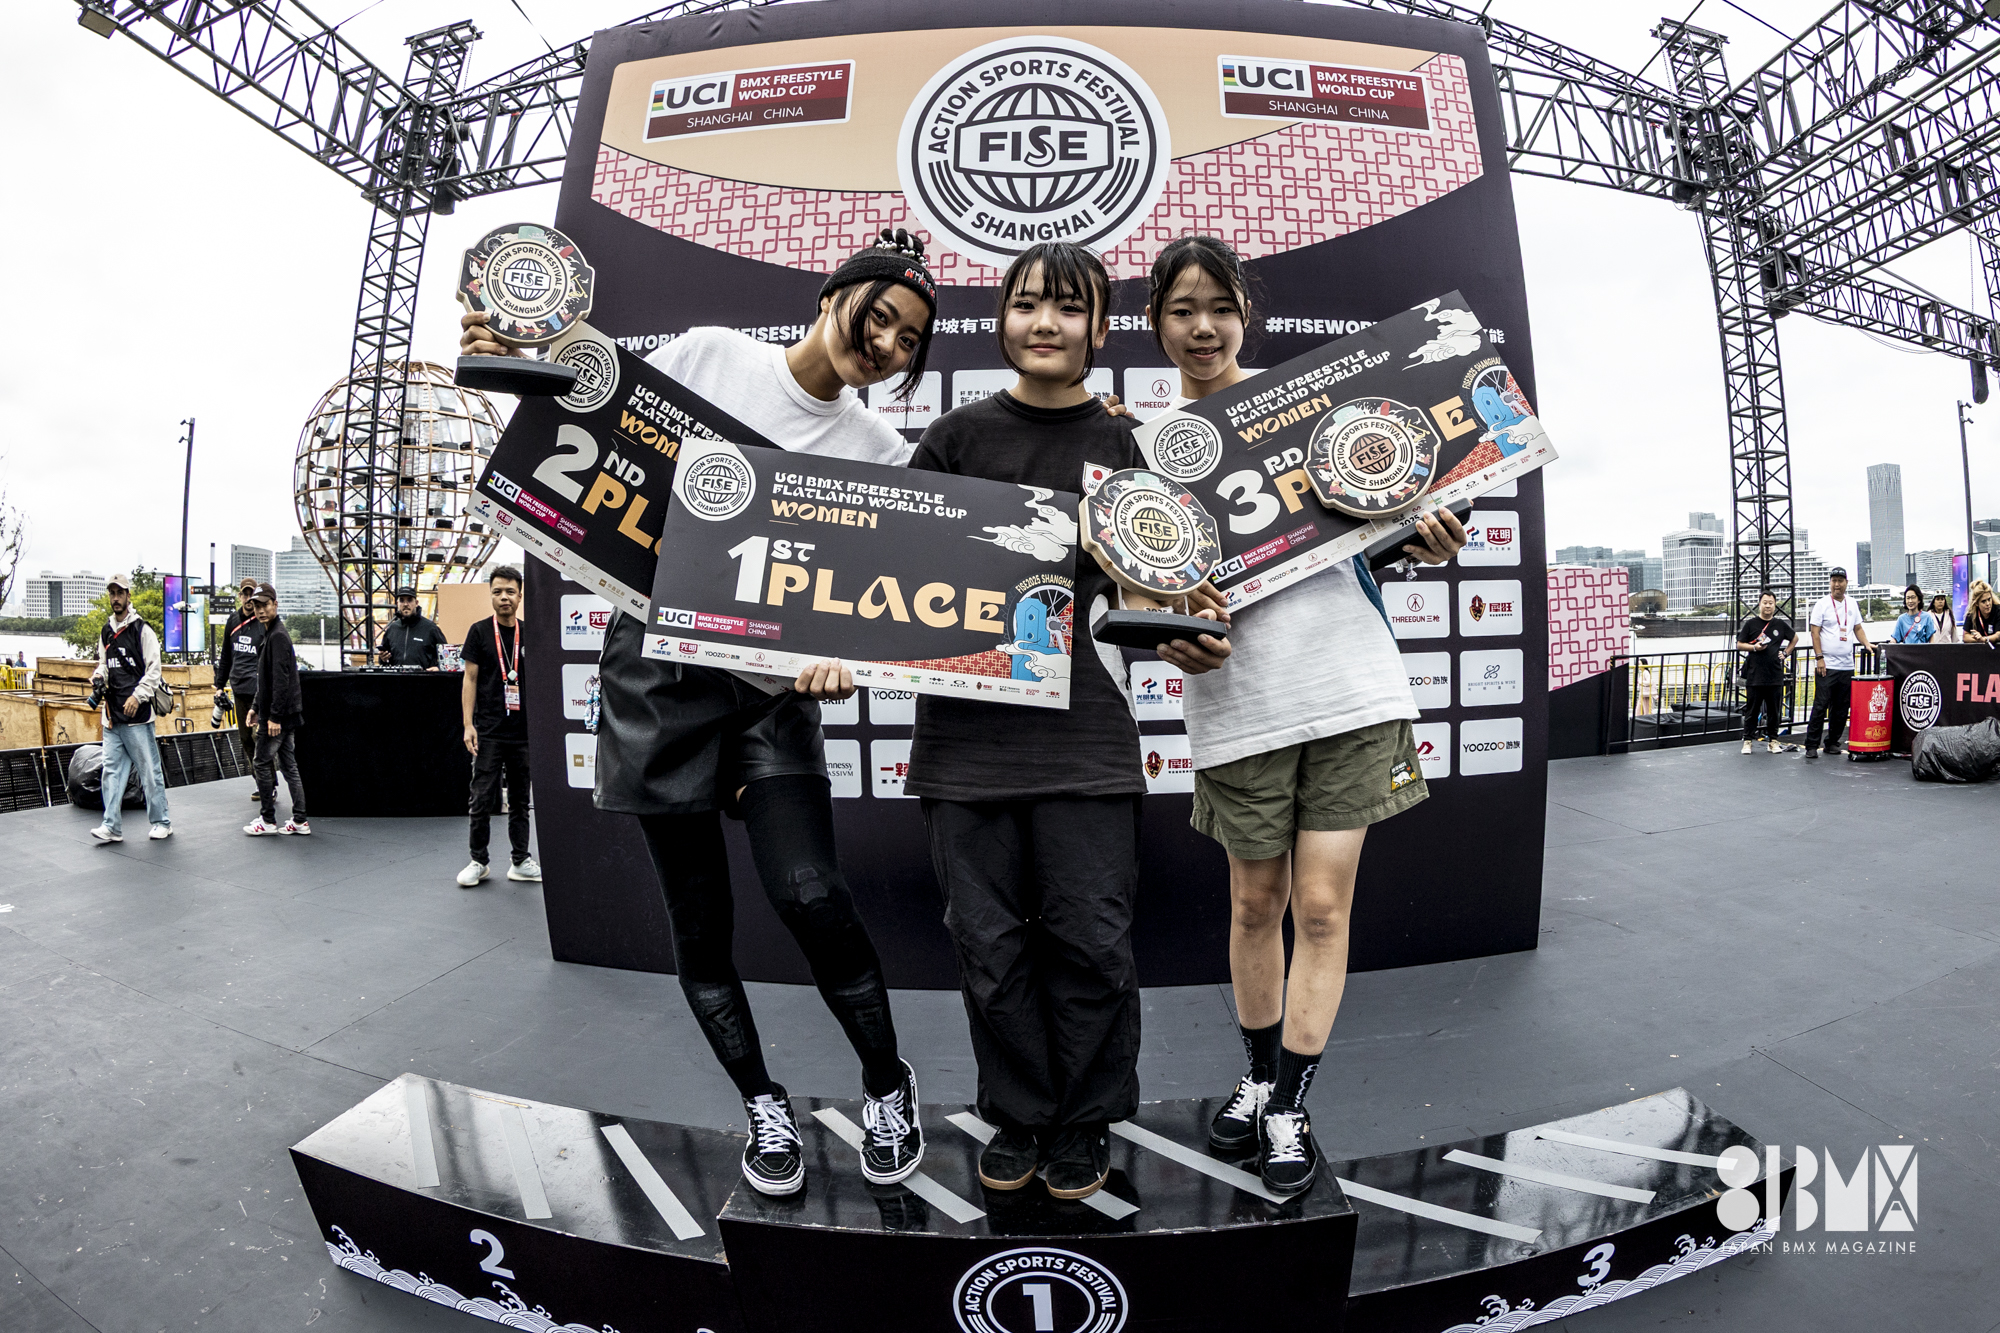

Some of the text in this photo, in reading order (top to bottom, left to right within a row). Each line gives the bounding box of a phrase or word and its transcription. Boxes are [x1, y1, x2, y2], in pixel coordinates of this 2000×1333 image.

[740, 70, 844, 88] BMX FREESTYLE
[1238, 65, 1305, 91] UCI
[1316, 71, 1418, 91] BMX FREESTYLE
[666, 81, 728, 109] UCI
[738, 84, 816, 101] WORLD CUP
[1318, 84, 1395, 100] WORLD CUP
[686, 106, 804, 128] SHANGHAI CHINA
[928, 59, 1140, 154] ACTION SPORTS FESTIVAL
[1268, 100, 1390, 120] SHANGHAI CHINA
[979, 125, 1087, 168] FISE
[971, 209, 1095, 242] SHANGHAI
[492, 246, 563, 286] ACTION SPORTS FESTIVAL
[510, 272, 544, 286] FISE
[504, 300, 544, 314] SHANGHAI
[560, 344, 612, 389] ACTION SPORTS FESTIVAL
[1462, 357, 1501, 390] FISE2025 SHANGHAI
[1225, 350, 1368, 418] UCI BMX FREESTYLE
[1231, 351, 1391, 427] FLATLAND WORLD CUP
[634, 384, 660, 404] UCI
[660, 401, 694, 427] BMX
[878, 405, 914, 413] THREEGUN
[1238, 393, 1332, 444] WOMEN
[1163, 422, 1186, 439] SPORTS
[1186, 421, 1211, 441] FESTIVAL
[1172, 437, 1200, 457] FISE
[1338, 421, 1402, 470] ACTION SPORTS FESTIVAL
[1358, 442, 1389, 465] FISE
[688, 457, 747, 489] ACTION SPORTS FESTIVAL
[1180, 458, 1211, 475] SHANGHAI
[1369, 465, 1405, 487] SHANGHAI
[494, 476, 519, 499] UCI
[702, 478, 732, 491] FISE
[774, 471, 945, 505] UCI BMX FREESTYLE
[518, 498, 546, 519] WORLD CUP
[520, 492, 558, 519] BMX FREESTYLE
[696, 501, 730, 512] SHANGHAI
[772, 484, 967, 520] FLATLAND WORLD CUP
[582, 471, 661, 556] PL
[771, 499, 878, 529] WOMEN
[1119, 494, 1190, 535] ACTION SPORTS FESTIVAL
[556, 522, 573, 536] CHINA
[559, 517, 585, 536] SHANGHAI
[1140, 522, 1173, 537] FISE
[1287, 525, 1314, 540] SHANGHAI
[1488, 529, 1511, 540] 光明
[1244, 539, 1284, 560] BMX FREESTYLE
[1290, 535, 1306, 545] CHINA
[1139, 550, 1179, 564] SHANGHAI
[1247, 552, 1266, 564] WORLD
[1216, 558, 1242, 578] UCI
[1267, 570, 1290, 583] YOOZOO
[1015, 573, 1074, 594] FISE2025 SHANGHAI
[767, 562, 1006, 634] PLACE
[665, 610, 693, 626] UCI
[697, 622, 719, 630] WORLD
[713, 617, 744, 626] FREESTYLE
[749, 622, 780, 631] SHANGHAI
[1392, 615, 1425, 623] THREEGUN
[233, 643, 257, 654] MEDIA
[680, 642, 697, 650] 光明
[1902, 674, 1938, 703] ACTION SPORTS FESTIVAL
[1910, 695, 1930, 708] FISE
[1463, 741, 1520, 752] YOOZOO 游族
[469, 1228, 516, 1280] 2
[1577, 1243, 1615, 1286] 3
[965, 1256, 1116, 1312] ACTION SPORTS FESTIVAL
[1022, 1284, 1054, 1331] 1
